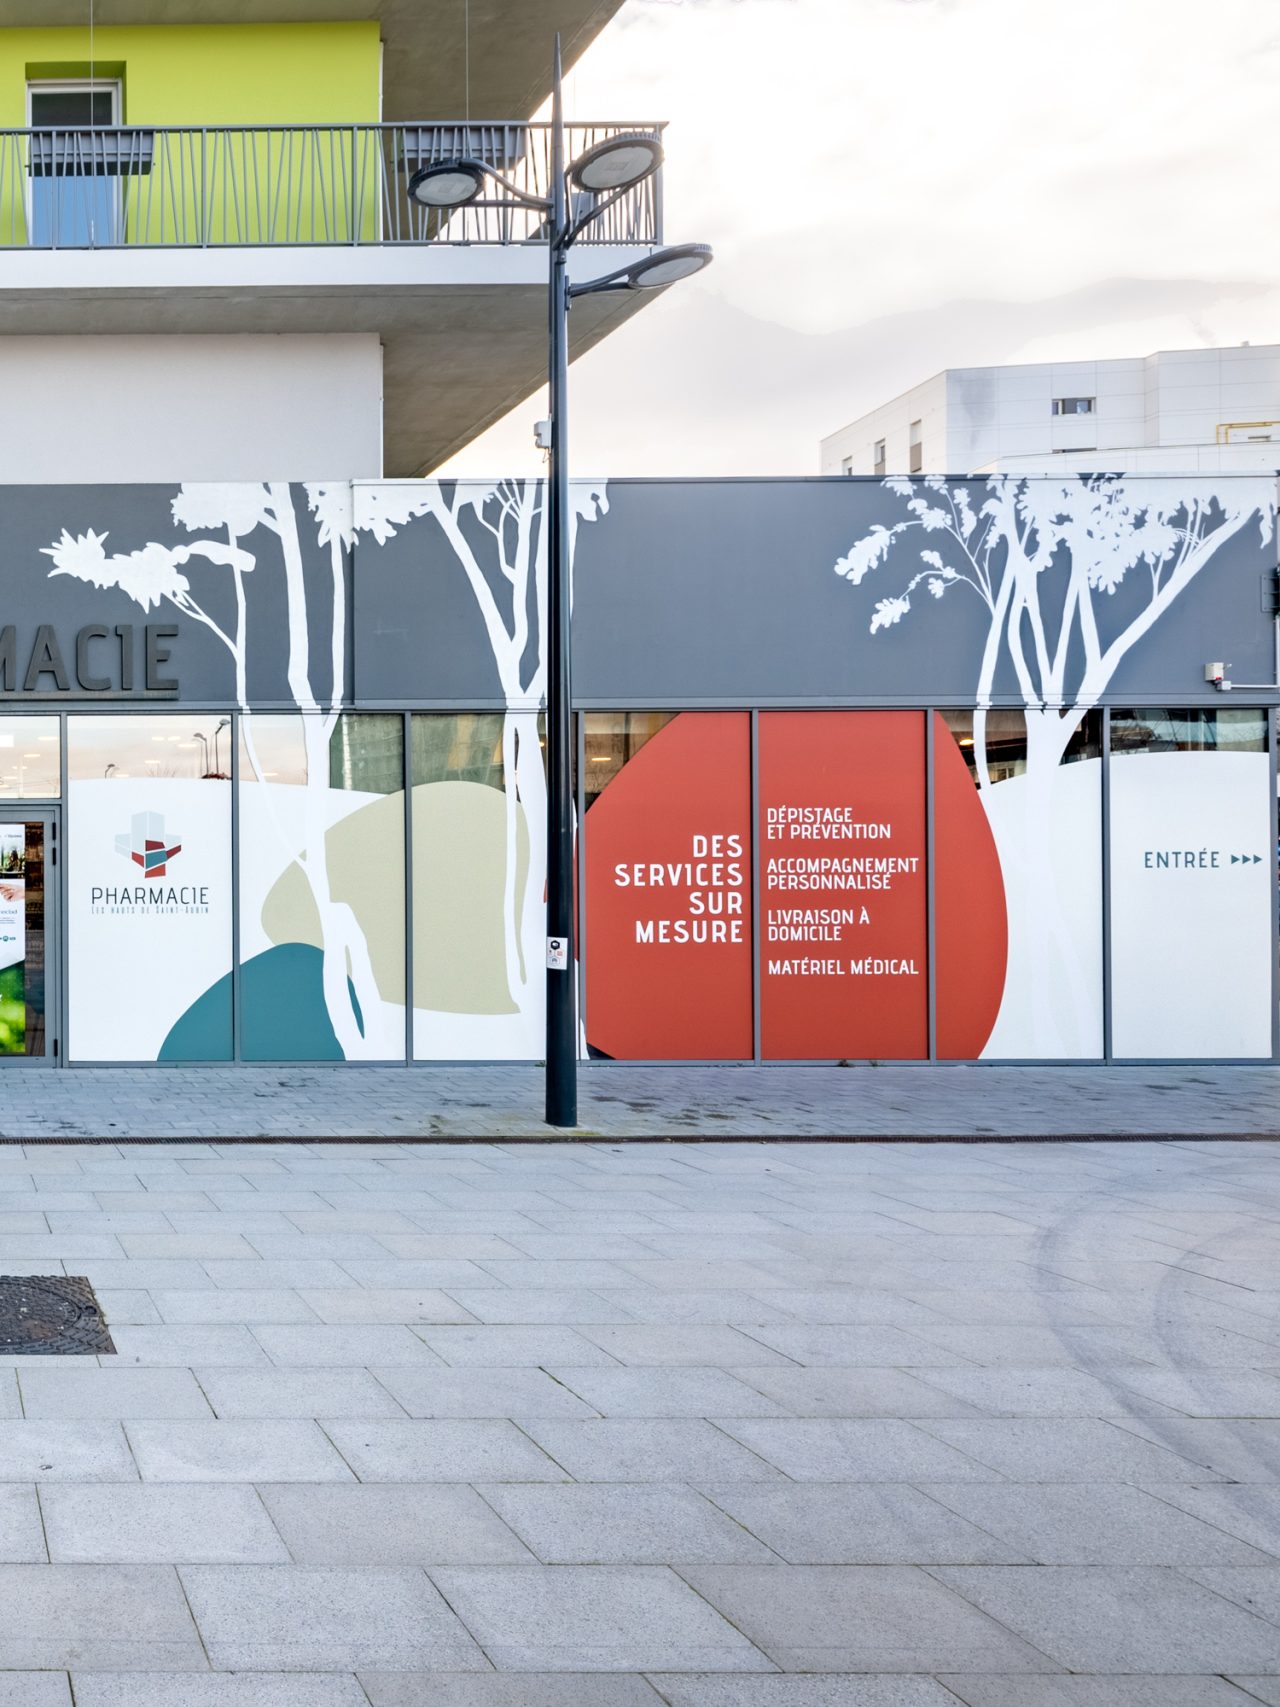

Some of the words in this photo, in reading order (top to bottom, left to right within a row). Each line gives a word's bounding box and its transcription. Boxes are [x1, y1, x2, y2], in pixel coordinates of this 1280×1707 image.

[767, 805, 852, 824] DÉPISTAGE
[767, 824, 786, 840] ET
[790, 820, 891, 840] PRÉVENTION
[692, 834, 743, 858] DES
[767, 857, 919, 873] ACCOMPAGNEMENT
[1144, 847, 1220, 868] ENTRÉE
[615, 863, 743, 887] SERVICES
[767, 870, 891, 890] PERSONNALISÉ
[91, 887, 209, 904] PHARMACIE
[689, 891, 743, 915] SUR
[768, 908, 854, 925] LIVRAISON
[859, 906, 870, 925] À
[635, 920, 743, 944] MESURE
[768, 925, 842, 941] DOMICILE
[768, 957, 845, 975] MATÉRIEL
[851, 957, 919, 975] MÉDICAL
